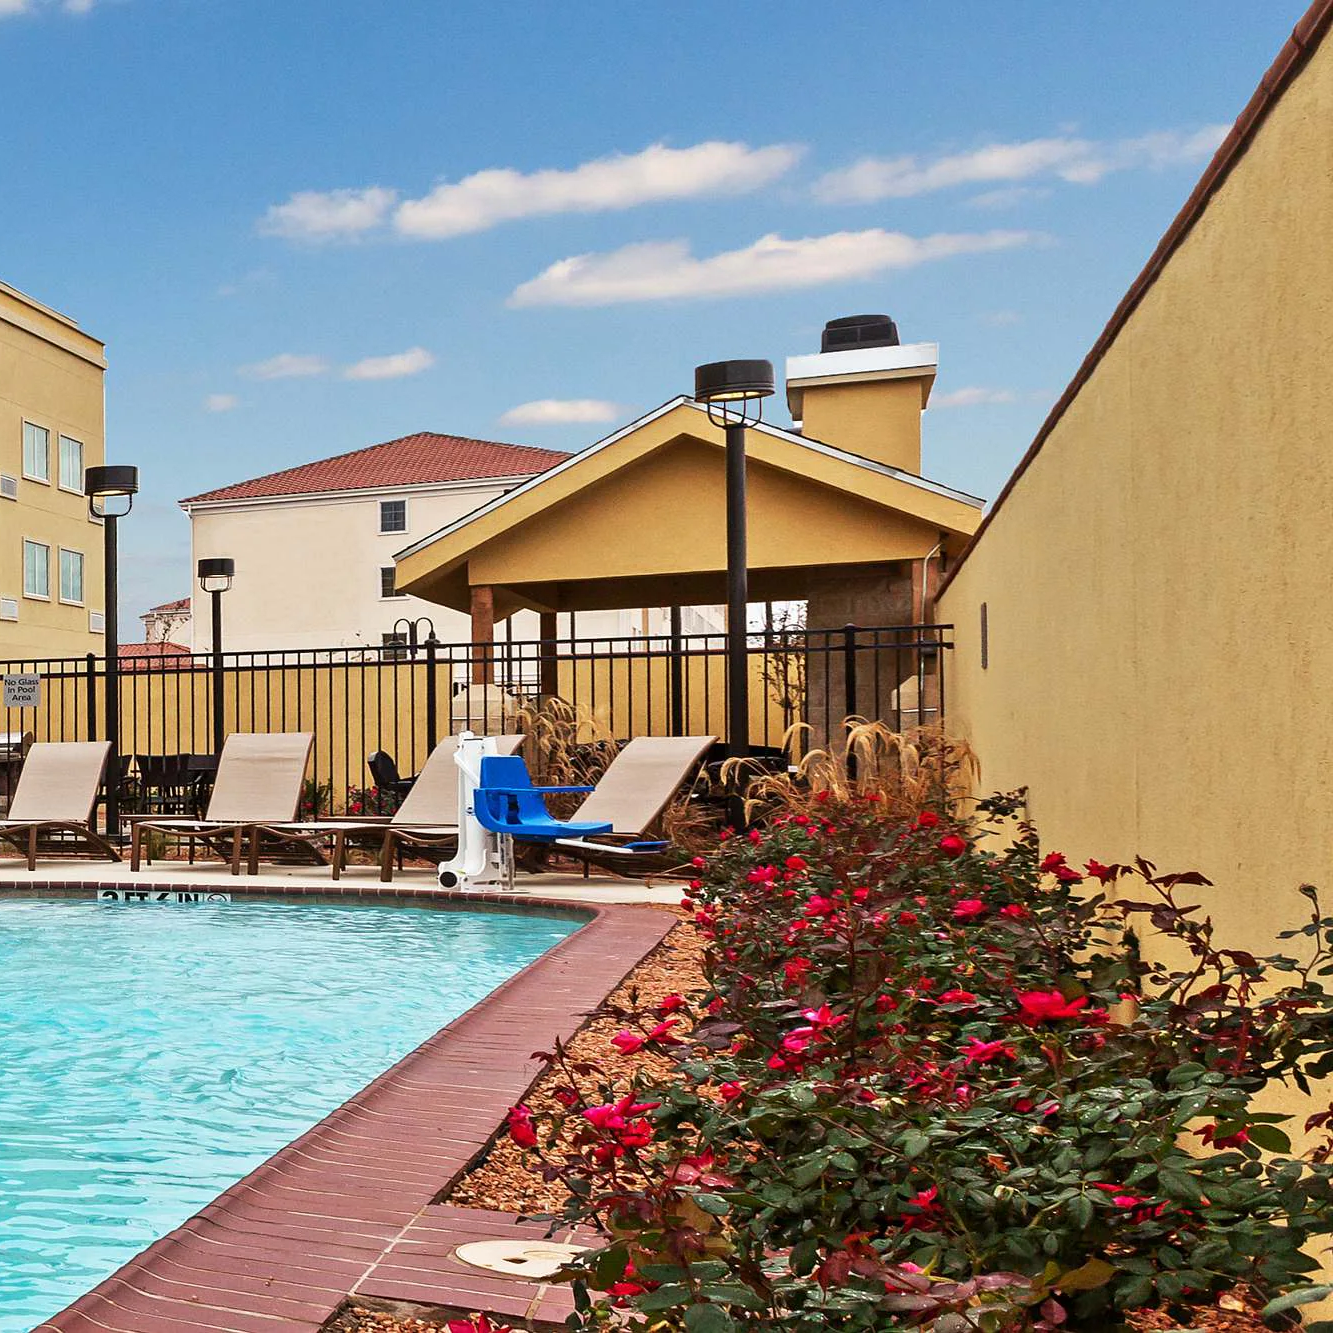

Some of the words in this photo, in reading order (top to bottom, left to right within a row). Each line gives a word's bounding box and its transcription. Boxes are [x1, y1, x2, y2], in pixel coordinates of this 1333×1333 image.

[4, 678, 17, 686] No
[18, 678, 39, 686] Glass
[17, 685, 36, 693] Pool
